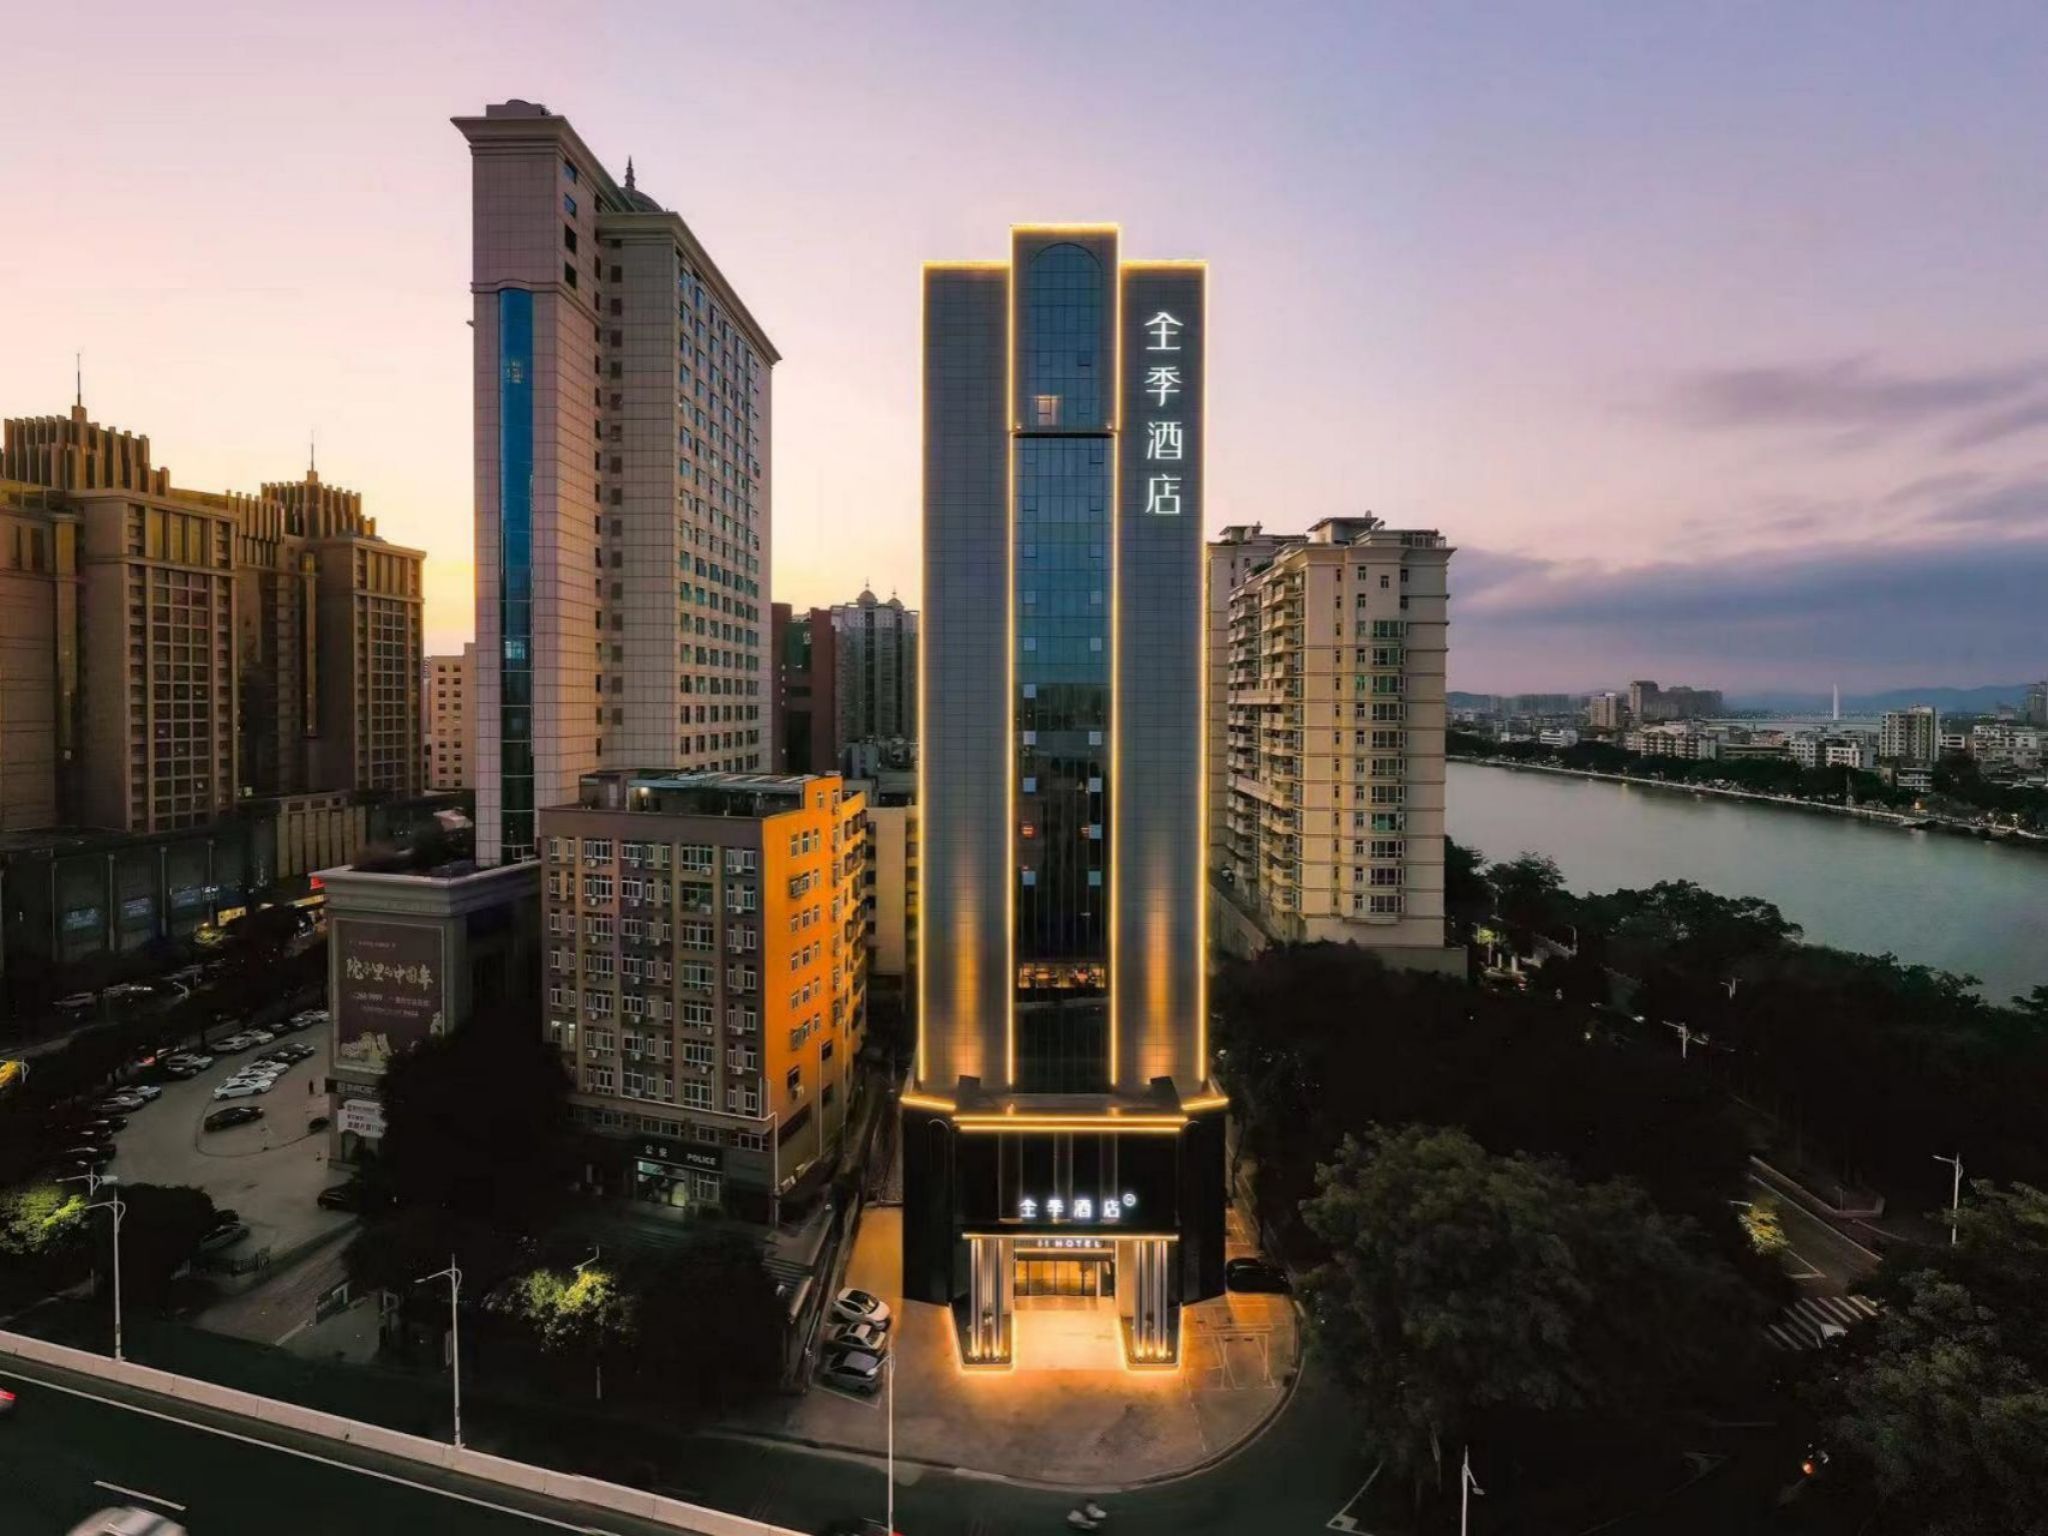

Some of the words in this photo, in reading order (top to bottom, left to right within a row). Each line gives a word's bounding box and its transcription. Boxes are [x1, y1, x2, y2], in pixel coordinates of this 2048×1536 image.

[1144, 311, 1184, 515] 全季酒店
[687, 1153, 716, 1166] POLICE
[1019, 1198, 1121, 1218] 全季酒店
[1055, 1239, 1102, 1248] HOTEL
